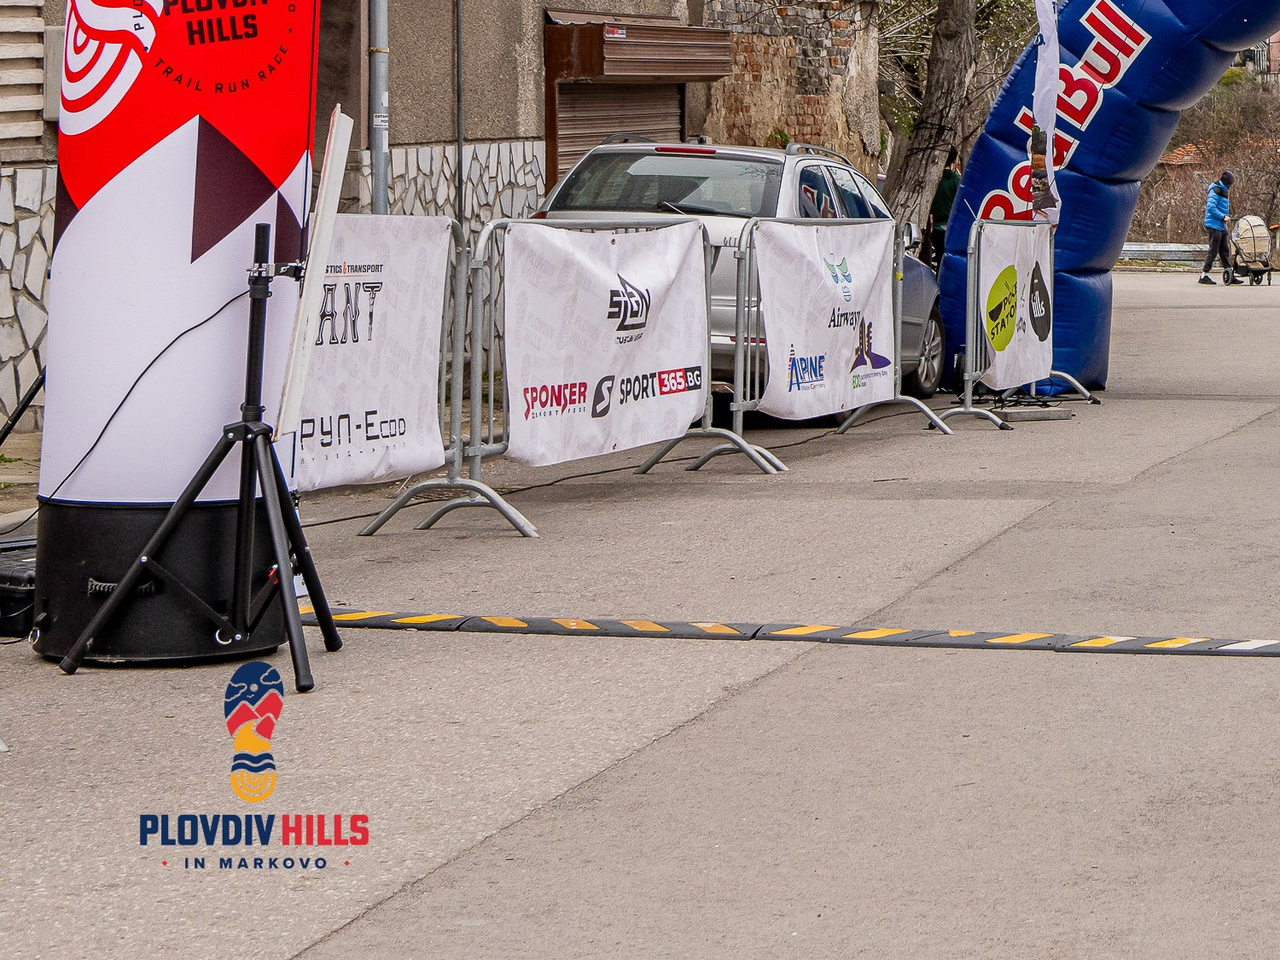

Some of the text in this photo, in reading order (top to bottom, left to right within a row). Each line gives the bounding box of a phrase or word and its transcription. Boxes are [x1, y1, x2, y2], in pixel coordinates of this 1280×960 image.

[186, 14, 258, 45] HILLS
[154, 45, 288, 93] TRAIL RUN RACE
[1056, 0, 1146, 126] Bull
[523, 382, 588, 420] SPONSER
